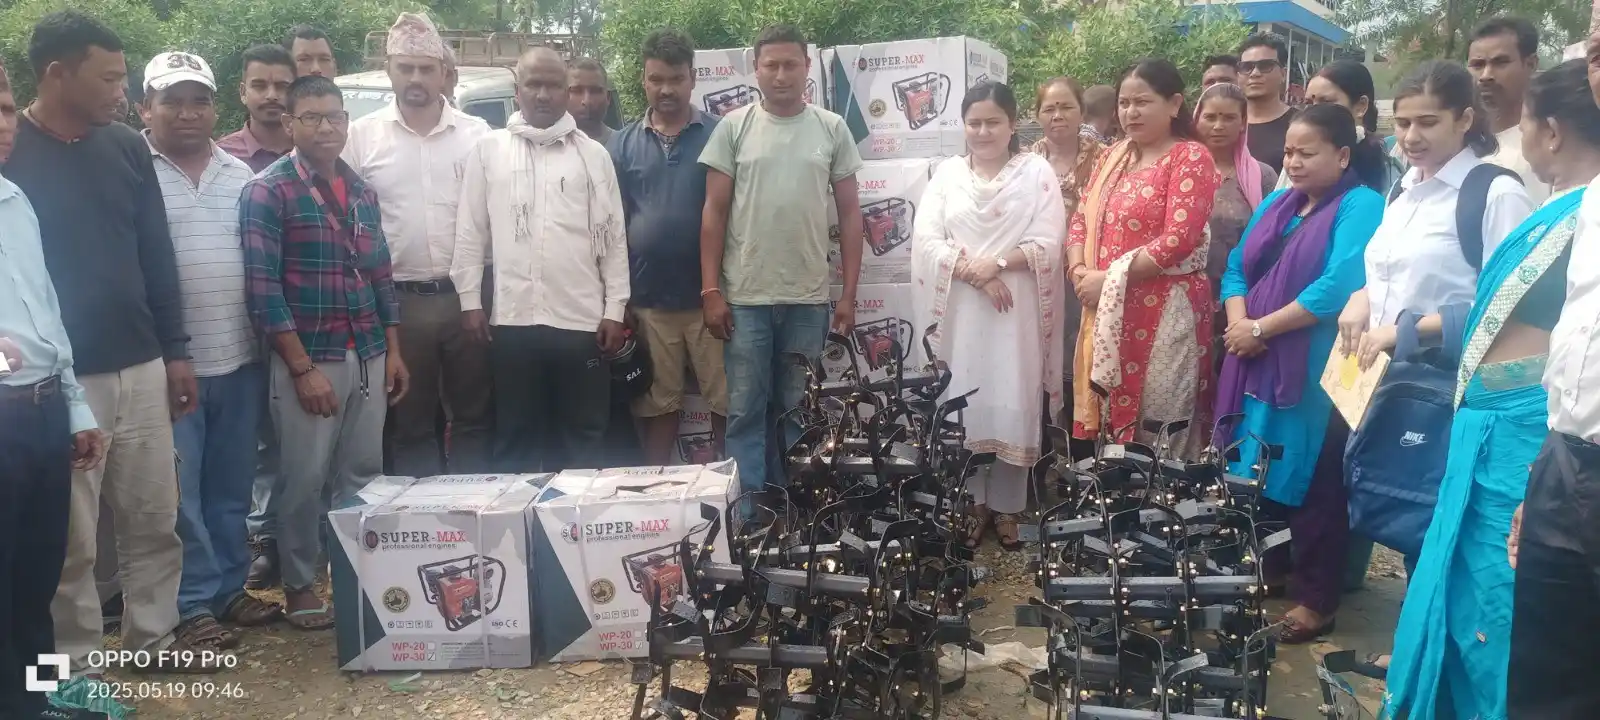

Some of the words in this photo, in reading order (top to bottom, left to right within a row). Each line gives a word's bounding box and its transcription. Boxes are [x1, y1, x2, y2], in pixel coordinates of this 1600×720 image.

[1404, 430, 1426, 443] NIKE
[585, 519, 670, 536] SUPER-MAX
[380, 531, 466, 543] SUPER-MAX
[382, 542, 427, 551] professional
[598, 630, 632, 641] WP-20
[391, 642, 425, 651] WP-20
[599, 641, 633, 651] WP-30
[391, 652, 425, 662] WP-30
